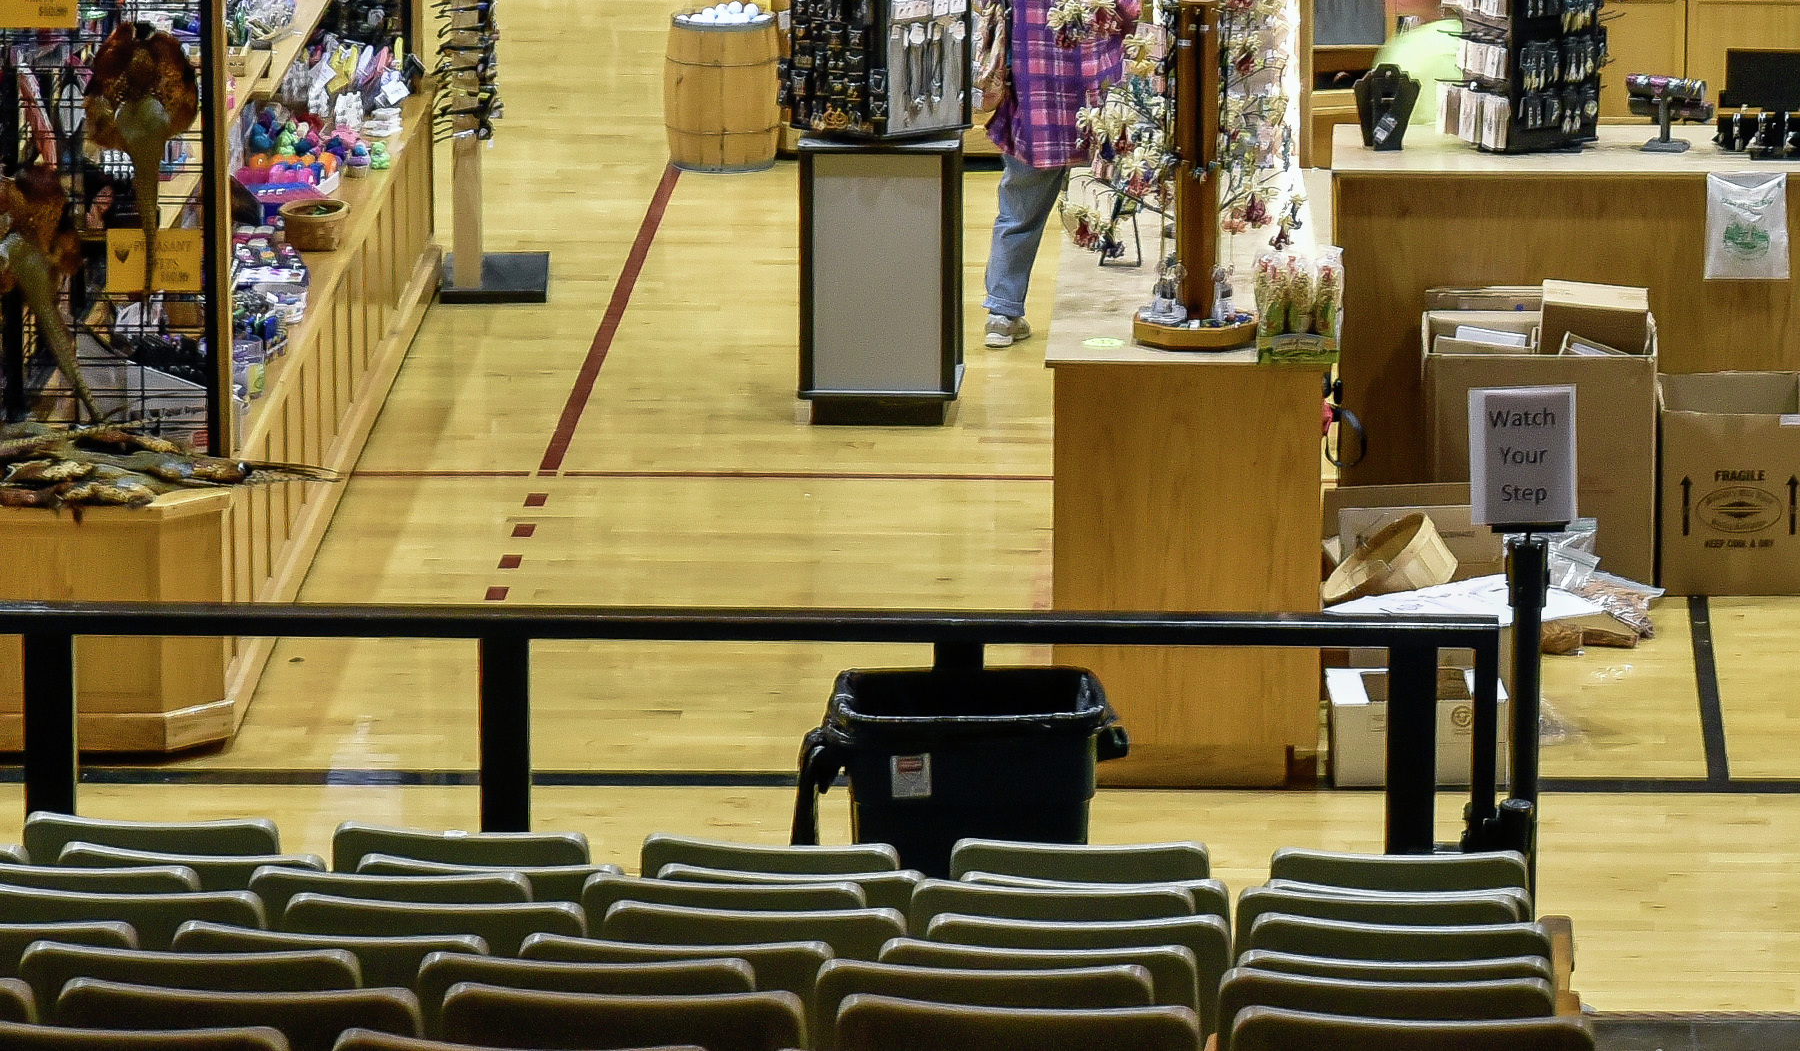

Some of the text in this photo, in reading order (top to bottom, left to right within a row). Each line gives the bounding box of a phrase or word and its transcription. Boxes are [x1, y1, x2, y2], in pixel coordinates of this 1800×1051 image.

[1488, 407, 1557, 428] Watch
[1499, 447, 1548, 465] Your
[1714, 470, 1766, 482] FRAGILE
[1501, 484, 1548, 505] Step
